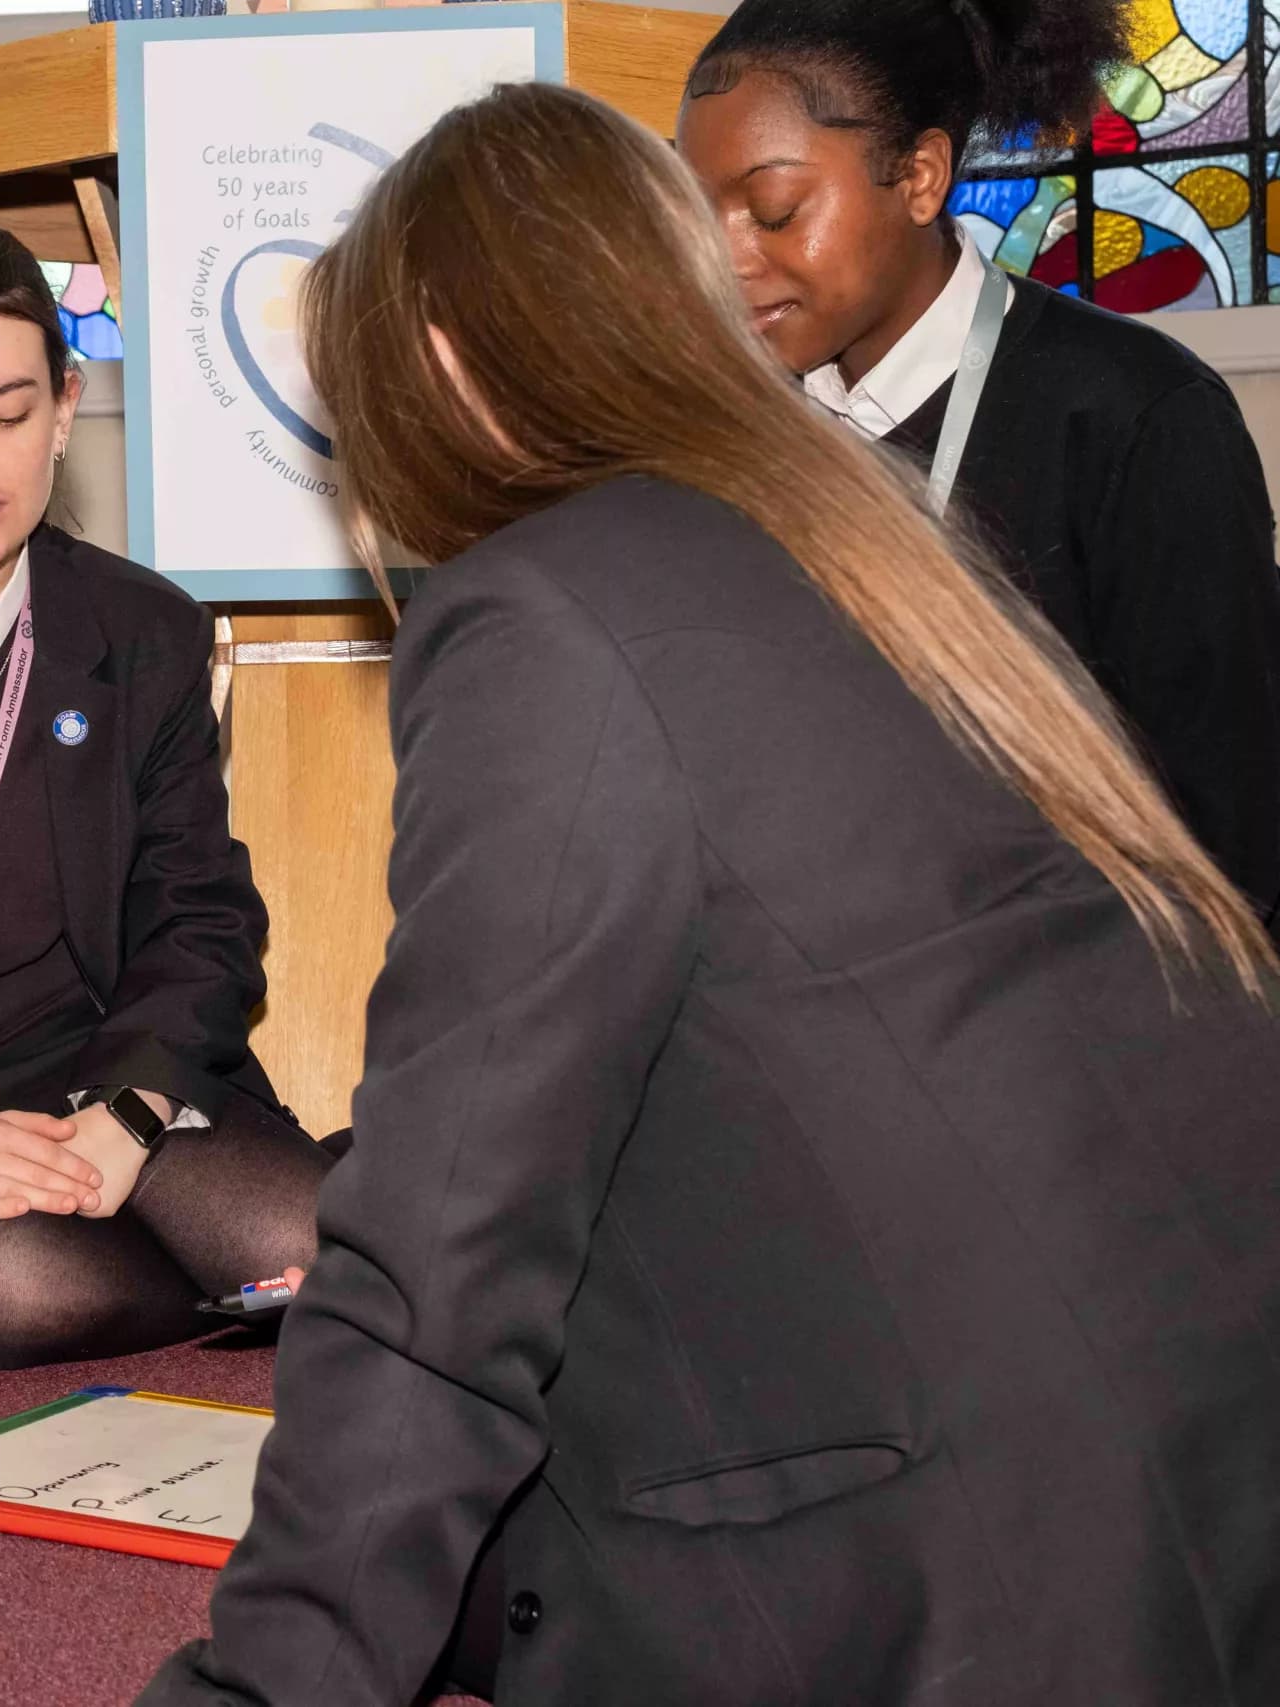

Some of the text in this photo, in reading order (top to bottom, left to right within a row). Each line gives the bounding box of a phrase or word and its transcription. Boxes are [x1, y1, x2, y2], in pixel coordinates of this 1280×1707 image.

[201, 143, 323, 168] Celebrating
[217, 176, 309, 201] 50 years
[223, 207, 310, 231] of Goals
[186, 245, 239, 409] personal growth
[246, 430, 339, 498] community
[5, 649, 29, 720] Ambassador
